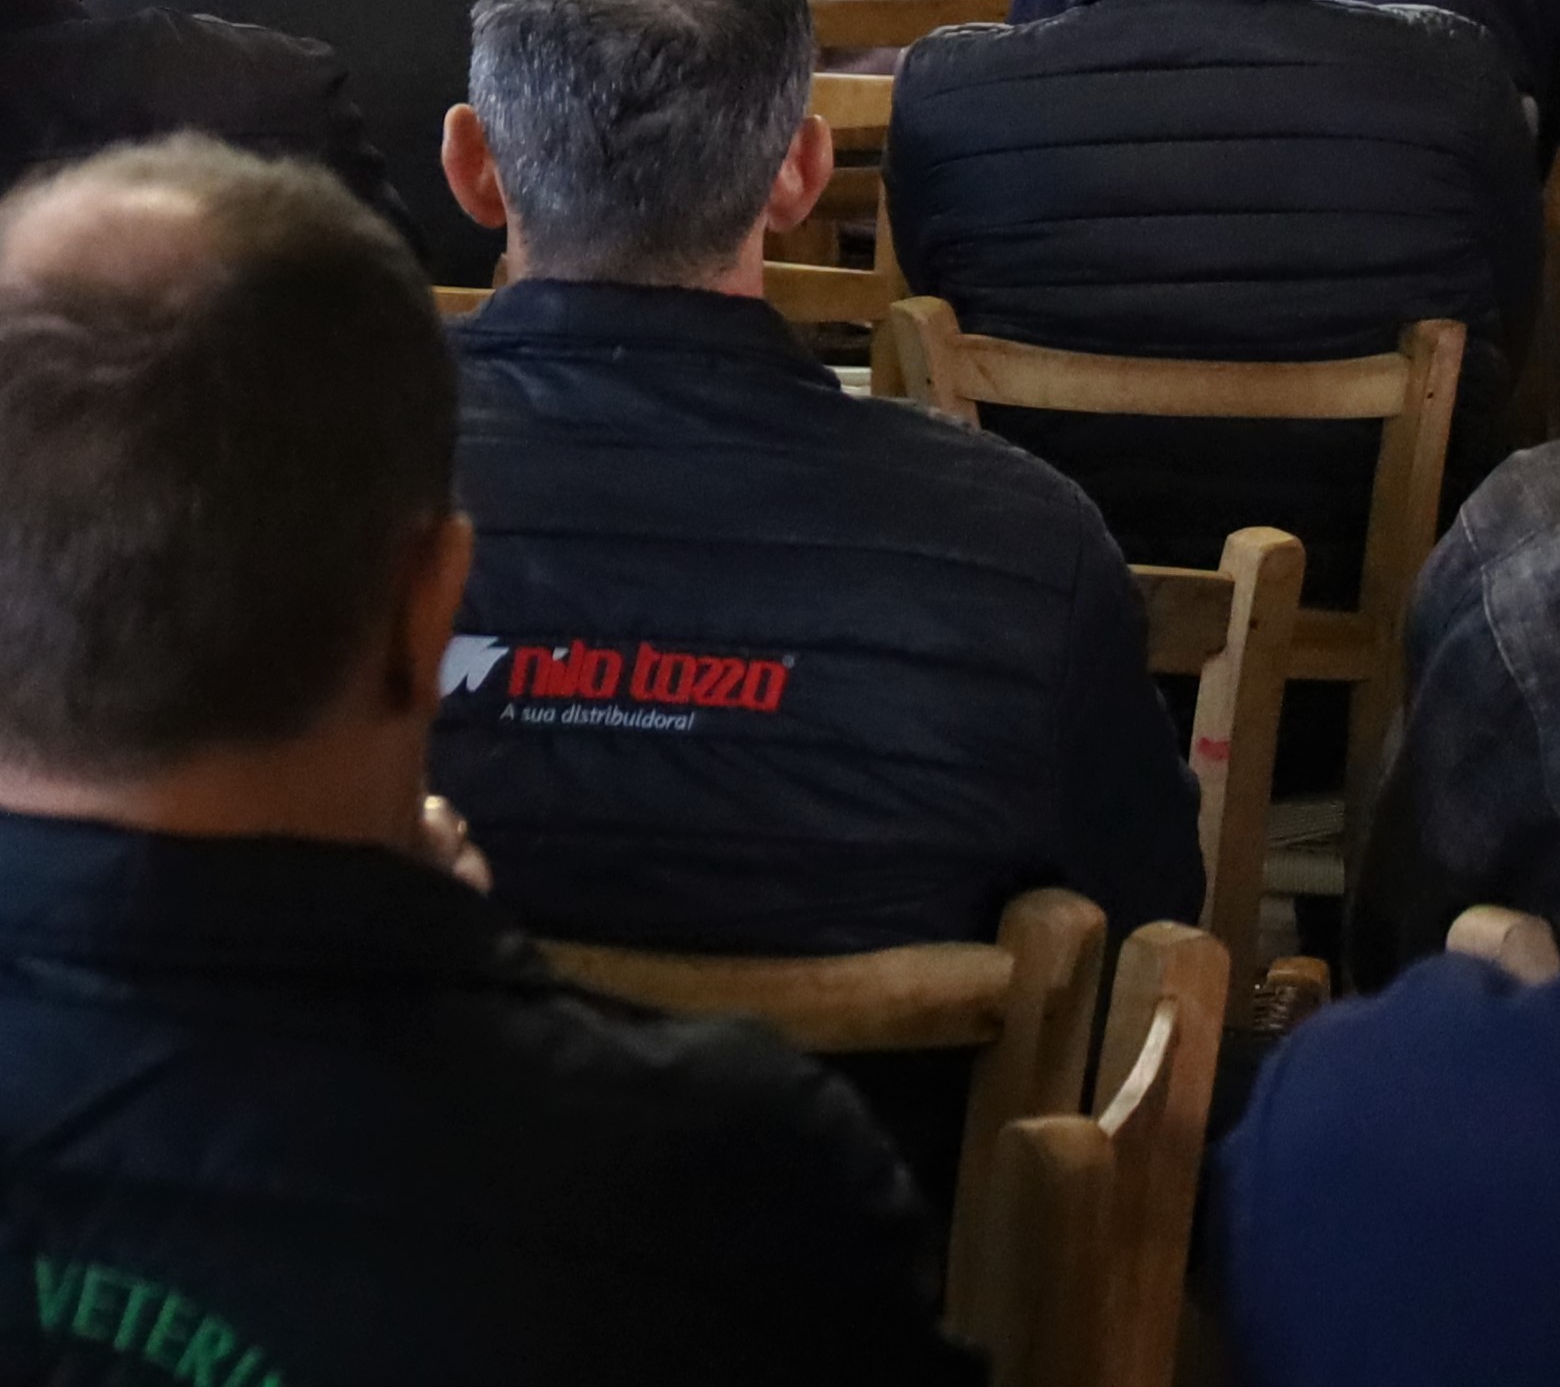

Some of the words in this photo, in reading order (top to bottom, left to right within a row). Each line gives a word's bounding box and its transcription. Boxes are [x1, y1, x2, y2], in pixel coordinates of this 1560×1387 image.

[499, 704, 515, 721] A
[520, 707, 556, 724] sua
[33, 1255, 282, 1387] VETERI
